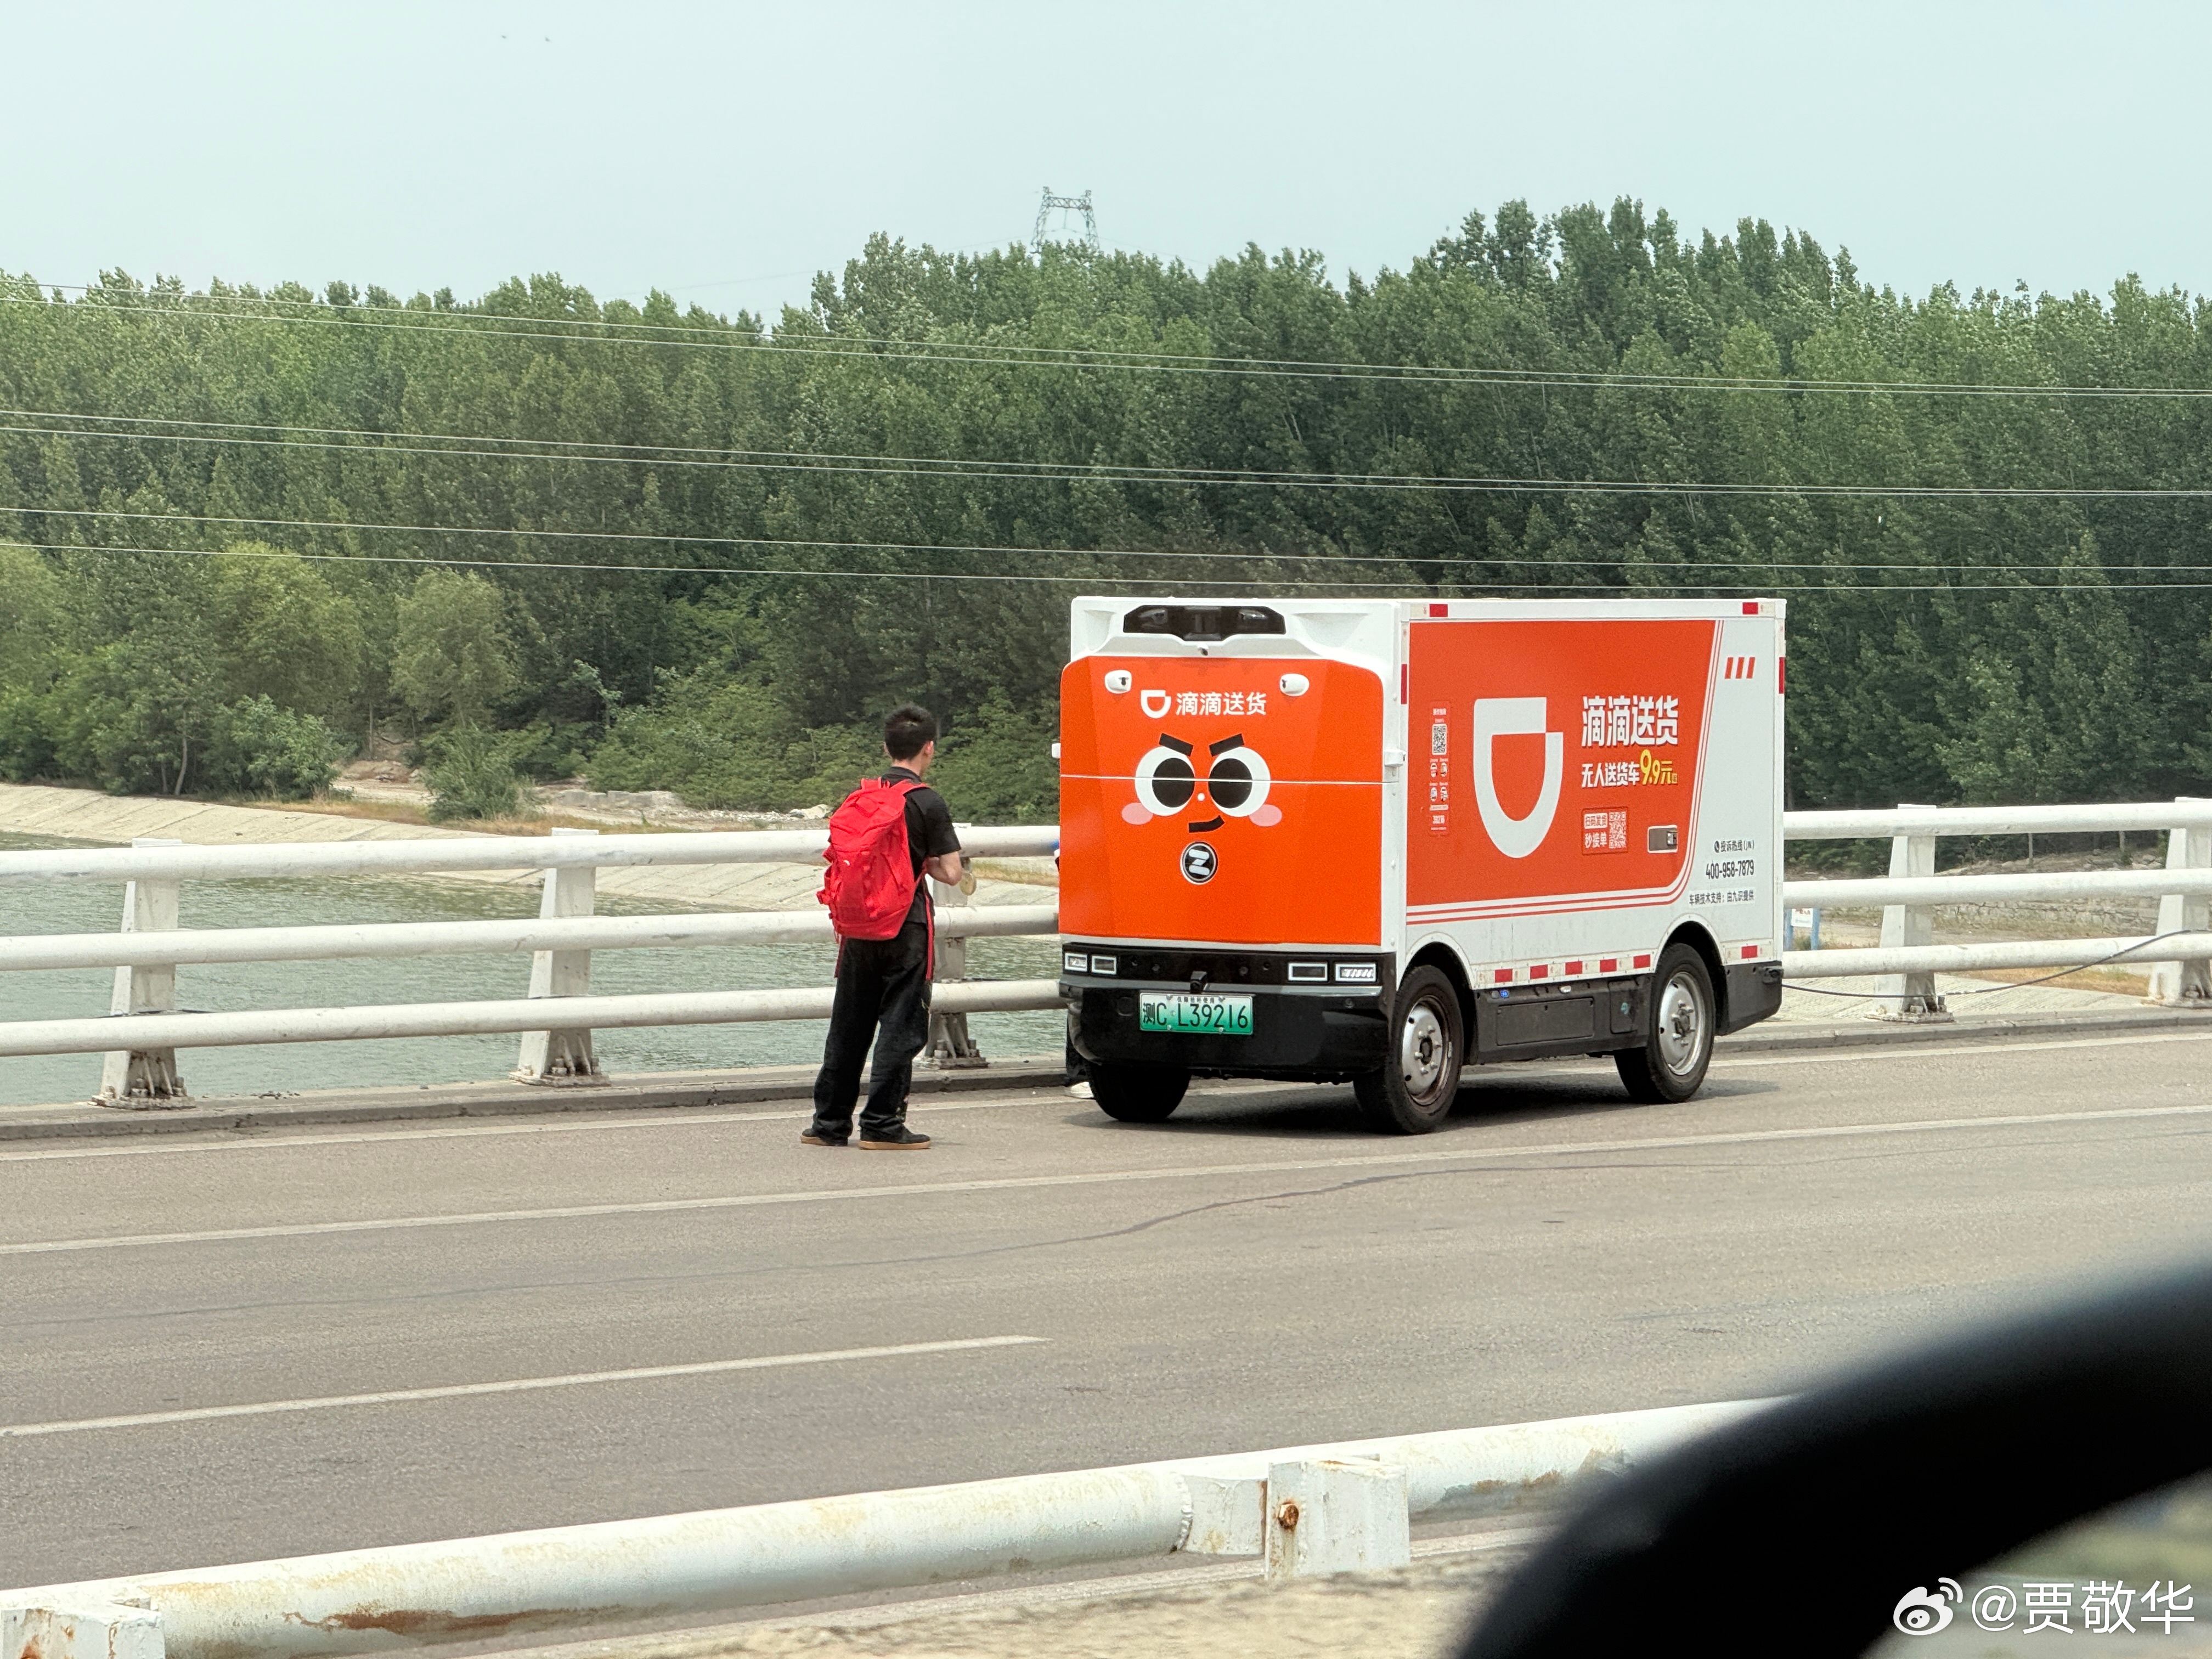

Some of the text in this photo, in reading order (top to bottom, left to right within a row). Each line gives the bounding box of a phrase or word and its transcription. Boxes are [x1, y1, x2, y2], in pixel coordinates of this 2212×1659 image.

[1176, 691, 1267, 716] 滴滴送货
[1581, 695, 1679, 747] 滴滴送货
[1584, 831, 1607, 849] 秒接单
[1706, 859, 1754, 879] 400-958-7879
